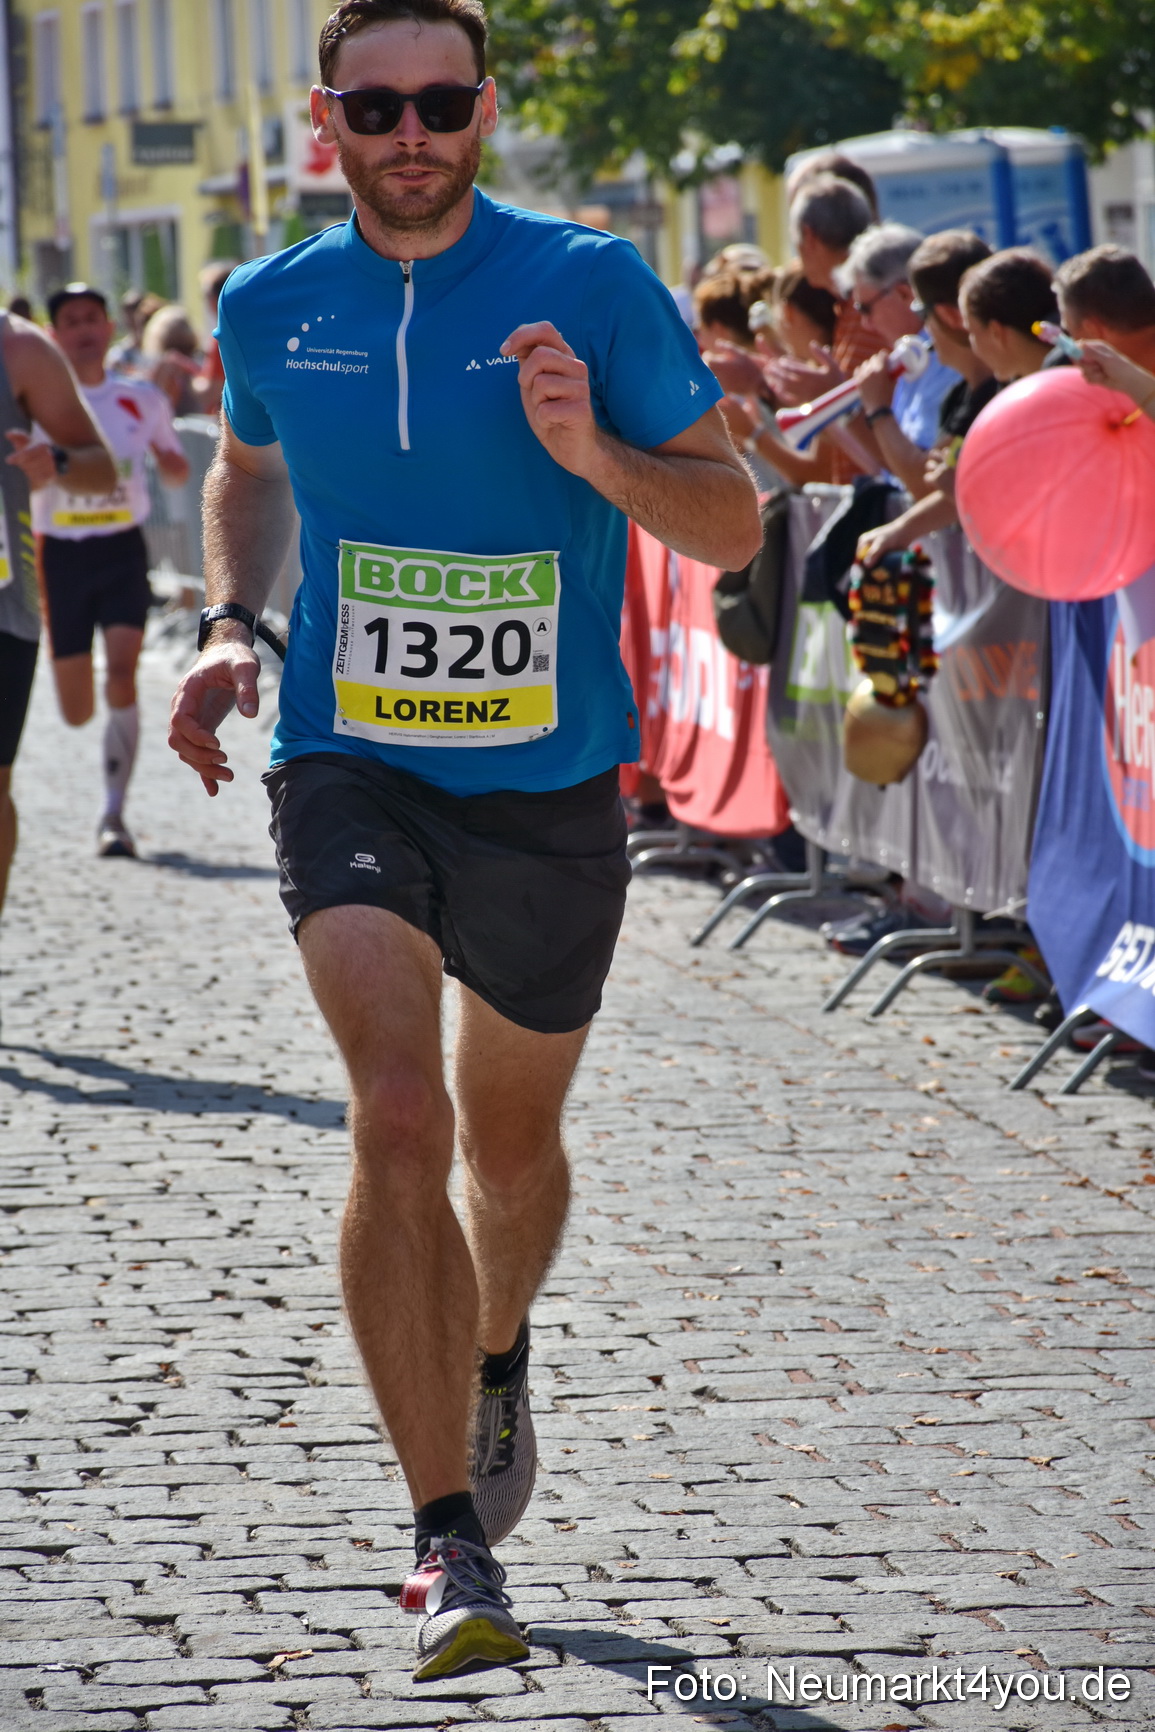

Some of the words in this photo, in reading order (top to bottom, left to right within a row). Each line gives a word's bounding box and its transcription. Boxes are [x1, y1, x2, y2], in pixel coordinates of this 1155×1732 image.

[306, 347, 335, 355] Universität
[335, 348, 369, 358] Regensburg
[486, 354, 519, 366] VAUD
[285, 359, 369, 375] Hochschulsport
[357, 554, 536, 604] BOCK
[536, 621, 548, 633] A
[364, 617, 531, 679] 1320
[375, 695, 511, 723] LORENZ
